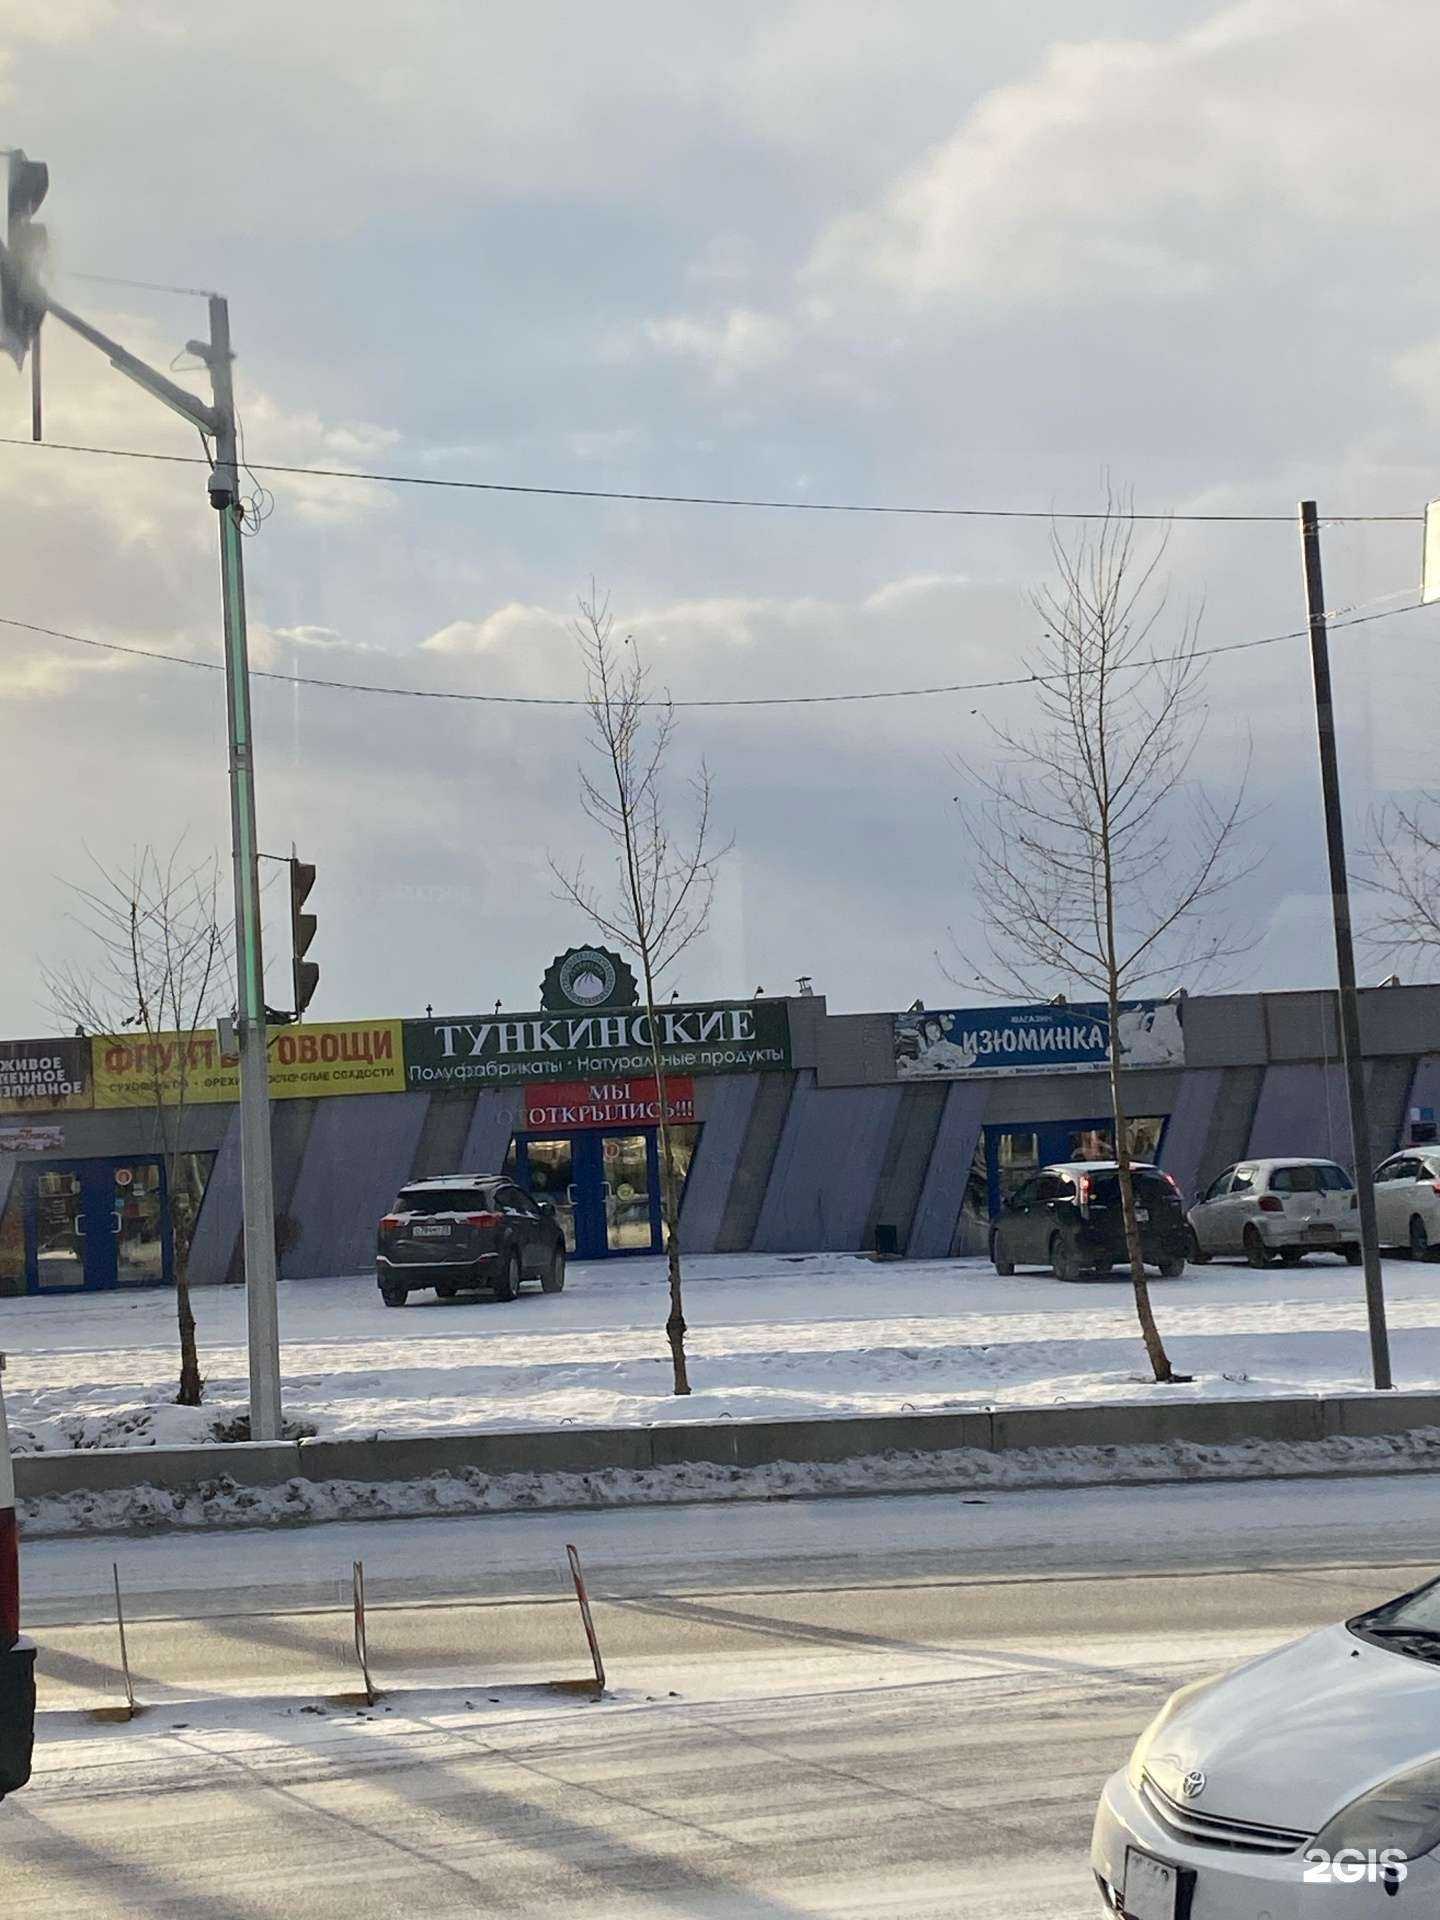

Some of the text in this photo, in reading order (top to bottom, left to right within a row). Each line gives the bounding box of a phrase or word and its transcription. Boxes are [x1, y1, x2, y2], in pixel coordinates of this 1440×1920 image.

[278, 1030, 392, 1065] ОВОЩИ
[434, 1009, 756, 1057] ТУНКИНСКИЕ
[962, 1025, 1104, 1055] ИЗЮМИНКА
[409, 1047, 784, 1081] Полуфабрикаты Натуралные продукты
[590, 1084, 631, 1100] МЫ
